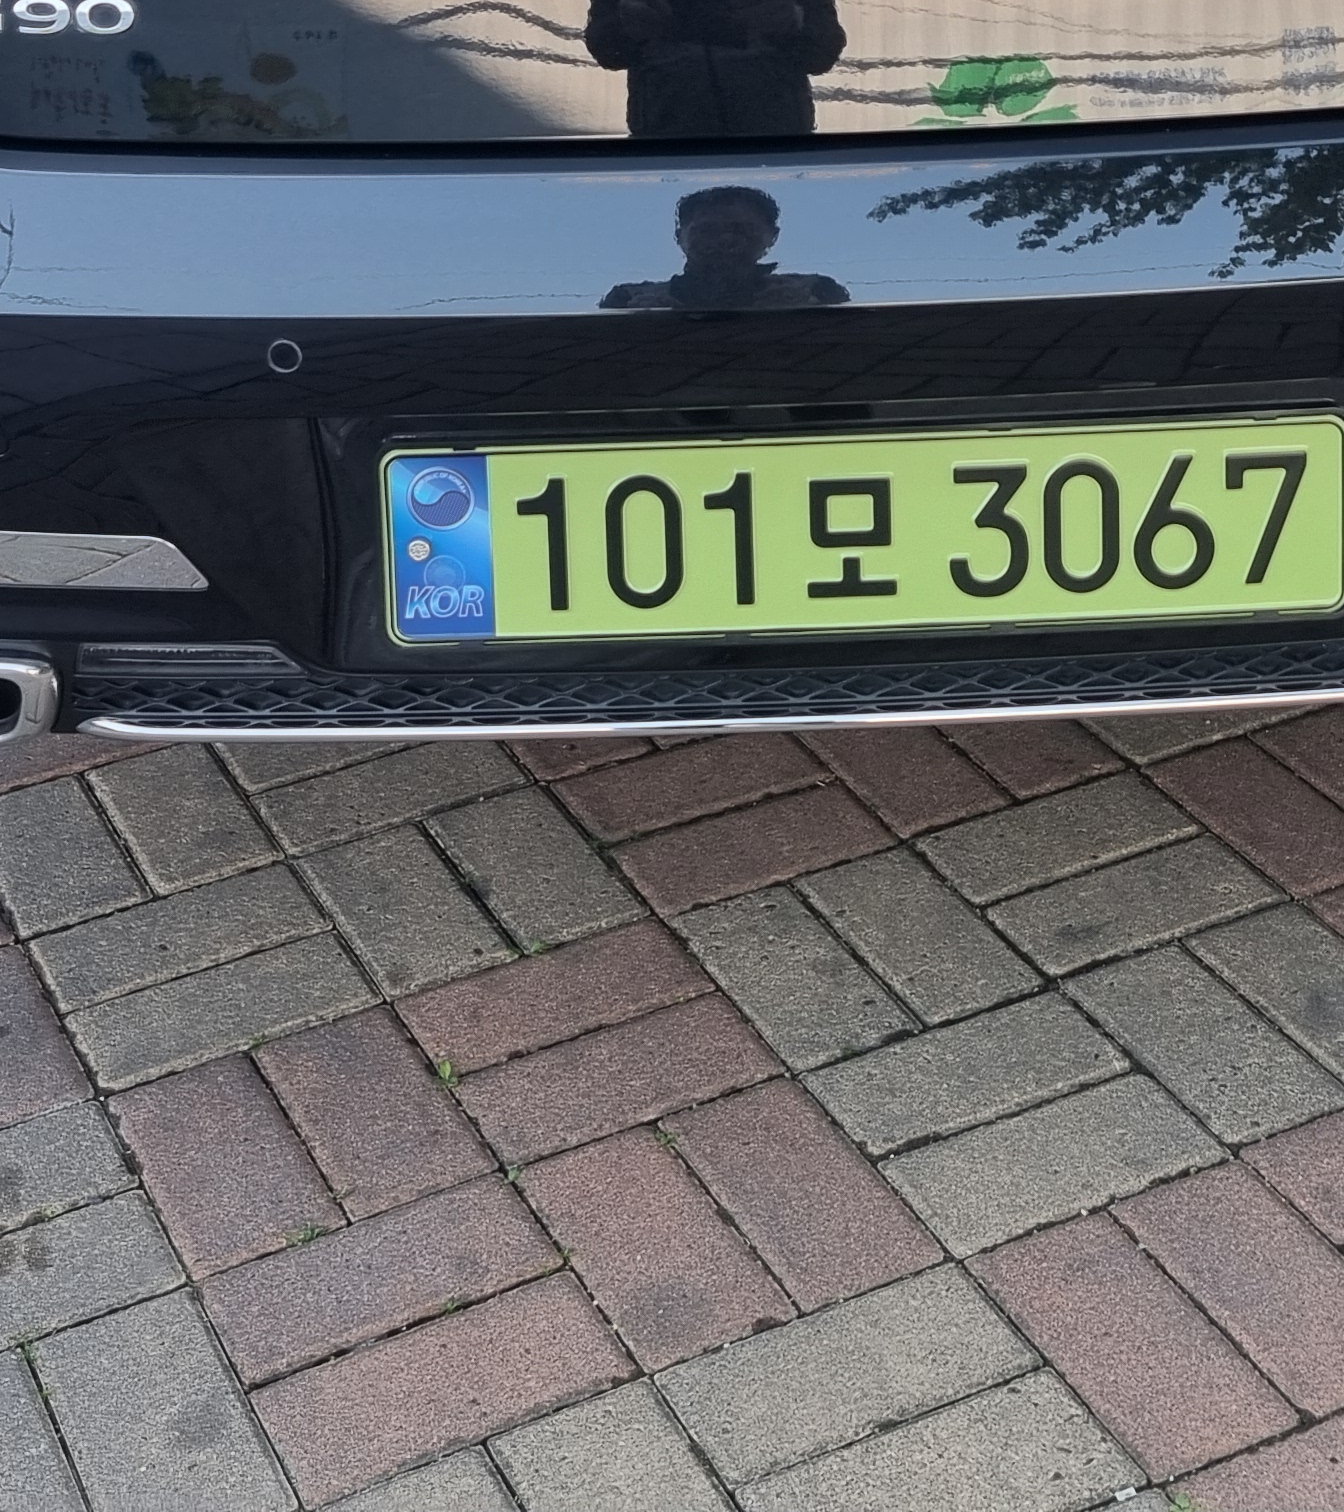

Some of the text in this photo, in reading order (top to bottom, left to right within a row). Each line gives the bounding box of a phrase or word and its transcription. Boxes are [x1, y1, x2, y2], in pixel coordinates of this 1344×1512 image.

[516, 450, 1309, 612] 101모 3067
[404, 585, 485, 619] KOR
